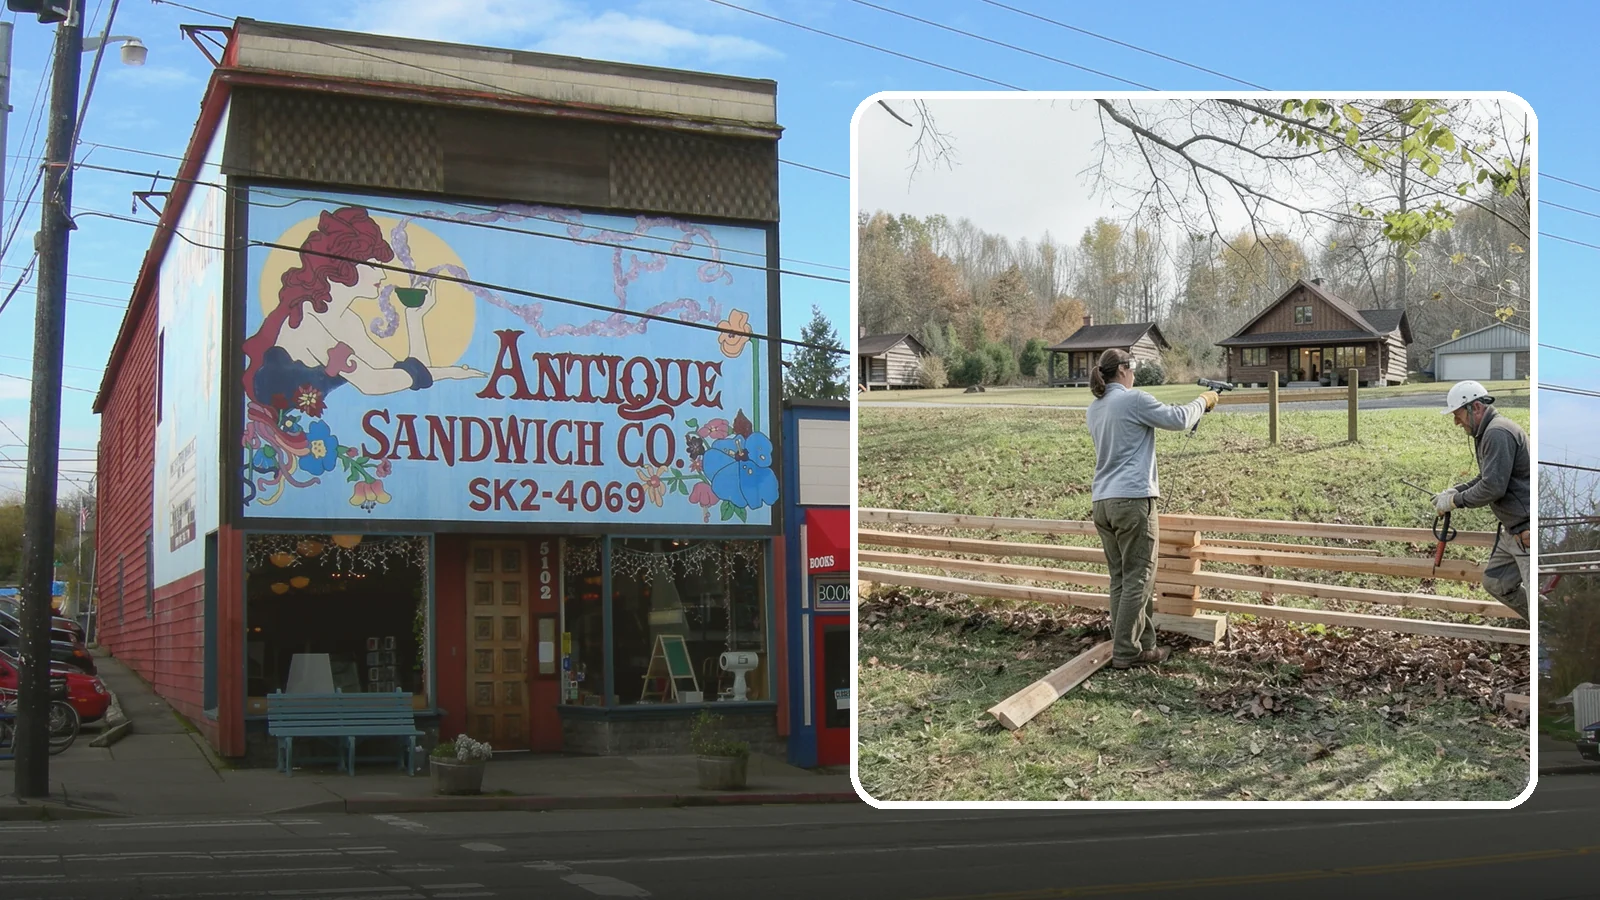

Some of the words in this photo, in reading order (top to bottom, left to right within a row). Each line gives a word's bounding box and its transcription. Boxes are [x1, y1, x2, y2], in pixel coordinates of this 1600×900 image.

[475, 329, 723, 421] ANTIQUE
[361, 408, 604, 467] SANDWICH
[617, 421, 685, 469] CO.
[468, 477, 645, 513] SK2-4069
[540, 541, 551, 600] 5102
[809, 555, 835, 569] BOOKS
